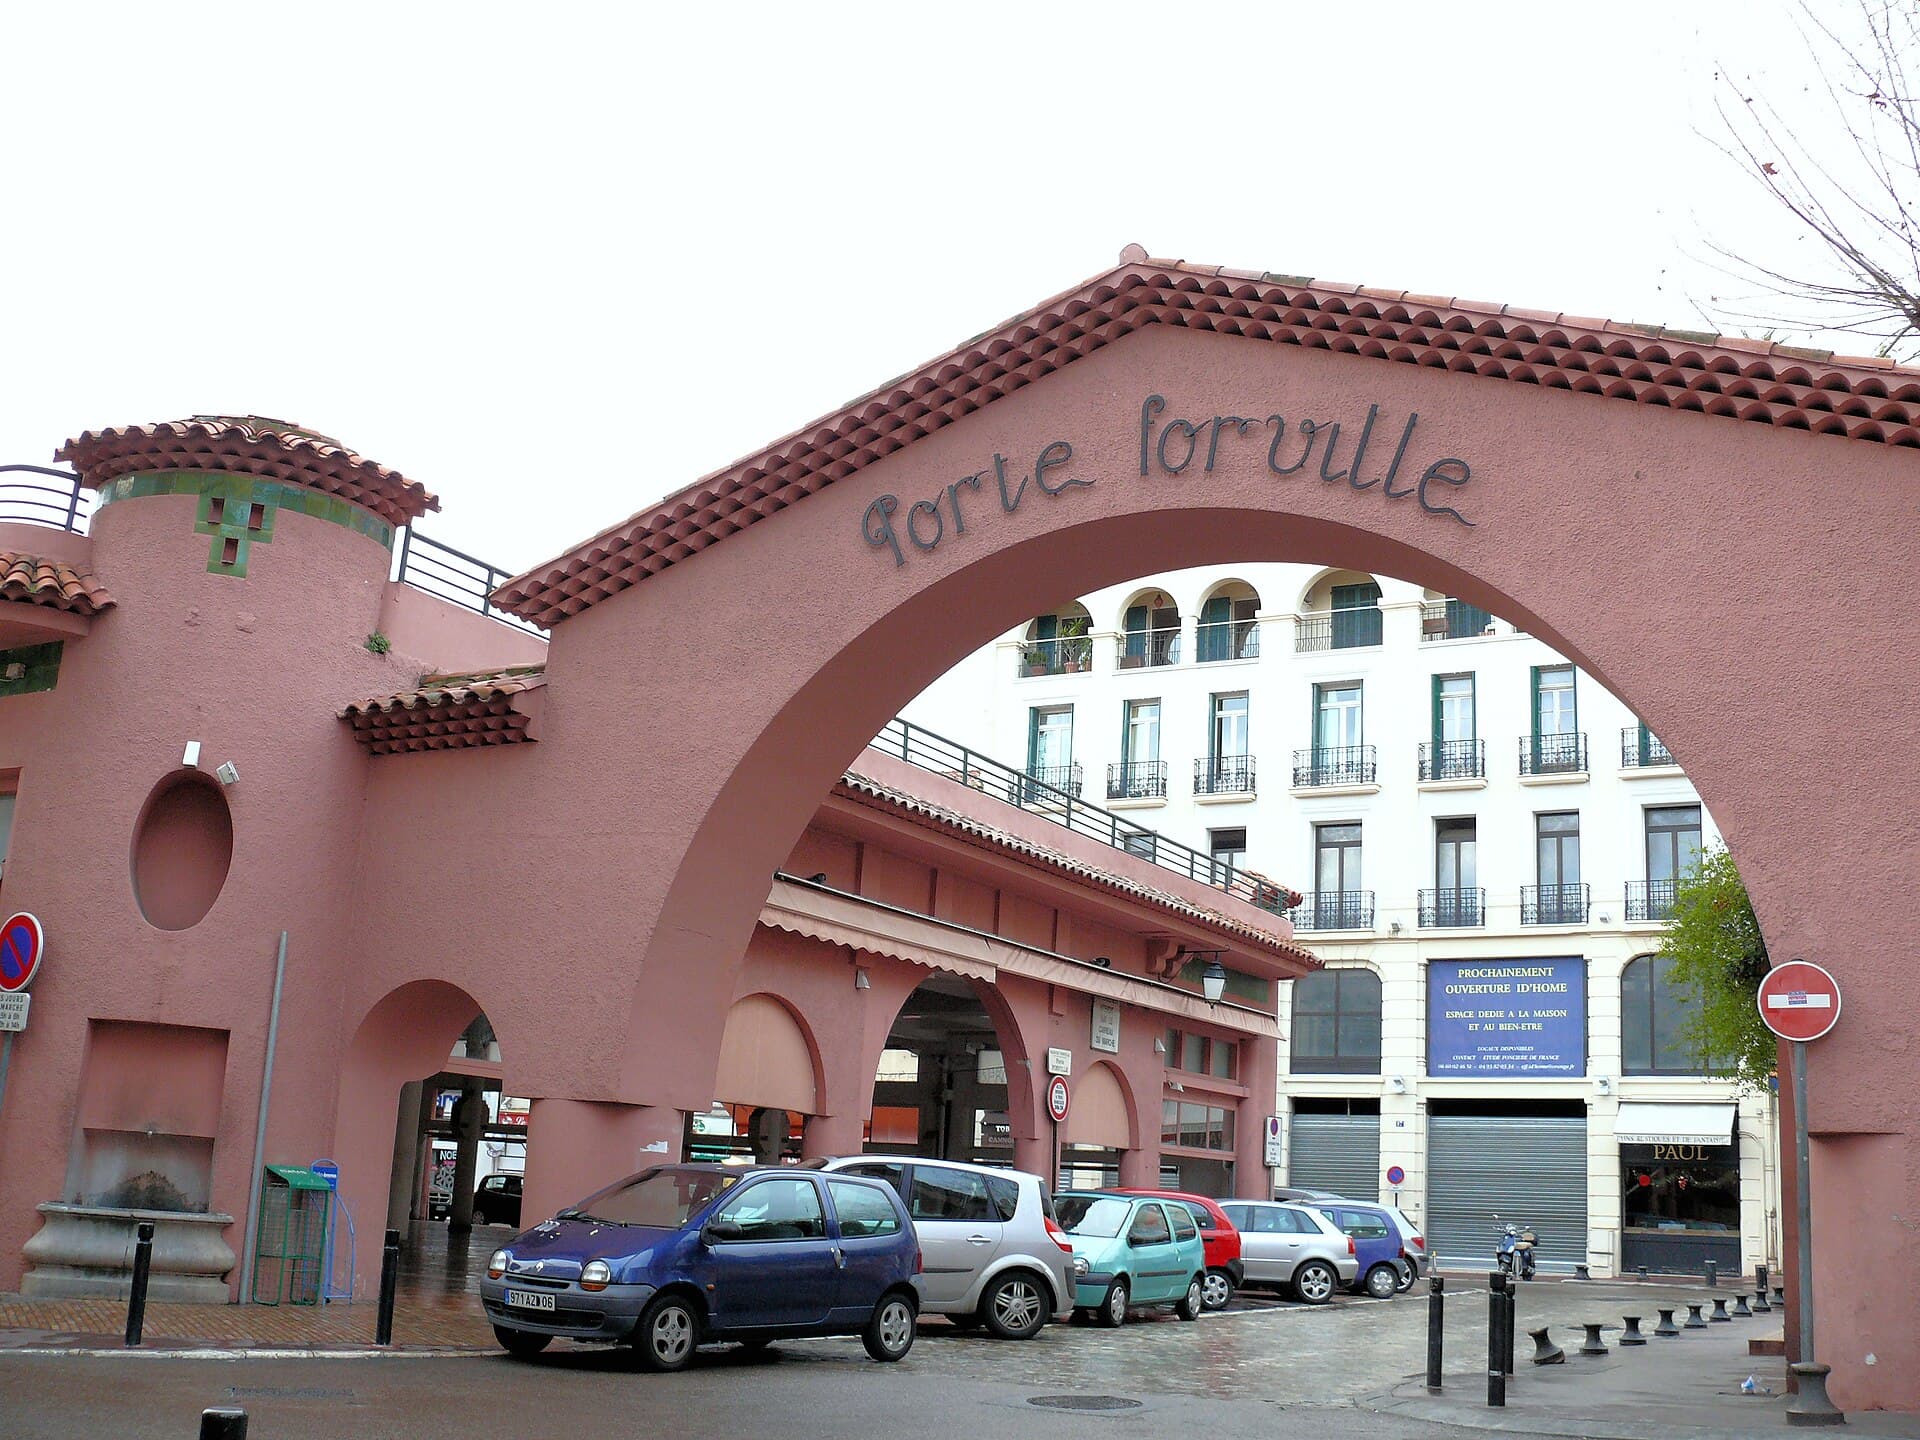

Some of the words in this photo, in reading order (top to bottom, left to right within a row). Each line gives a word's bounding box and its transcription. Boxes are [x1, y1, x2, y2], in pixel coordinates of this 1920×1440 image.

[1457, 967, 1554, 978] PROCHAINEMENT
[1445, 984, 1511, 994] OUVERTURE
[1516, 983, 1568, 993] ID'HOME
[1445, 1010, 1474, 1019] ESPACE
[1478, 1010, 1505, 1018] DEDIE
[1508, 1010, 1515, 1018] A
[1518, 1010, 1529, 1018] LA
[1533, 1009, 1568, 1017] MAISON
[1468, 1023, 1479, 1031] ET
[1483, 1023, 1495, 1031] AU
[1498, 1023, 1543, 1031] BIEN-ETRE
[1653, 1144, 1709, 1160] PAUL
